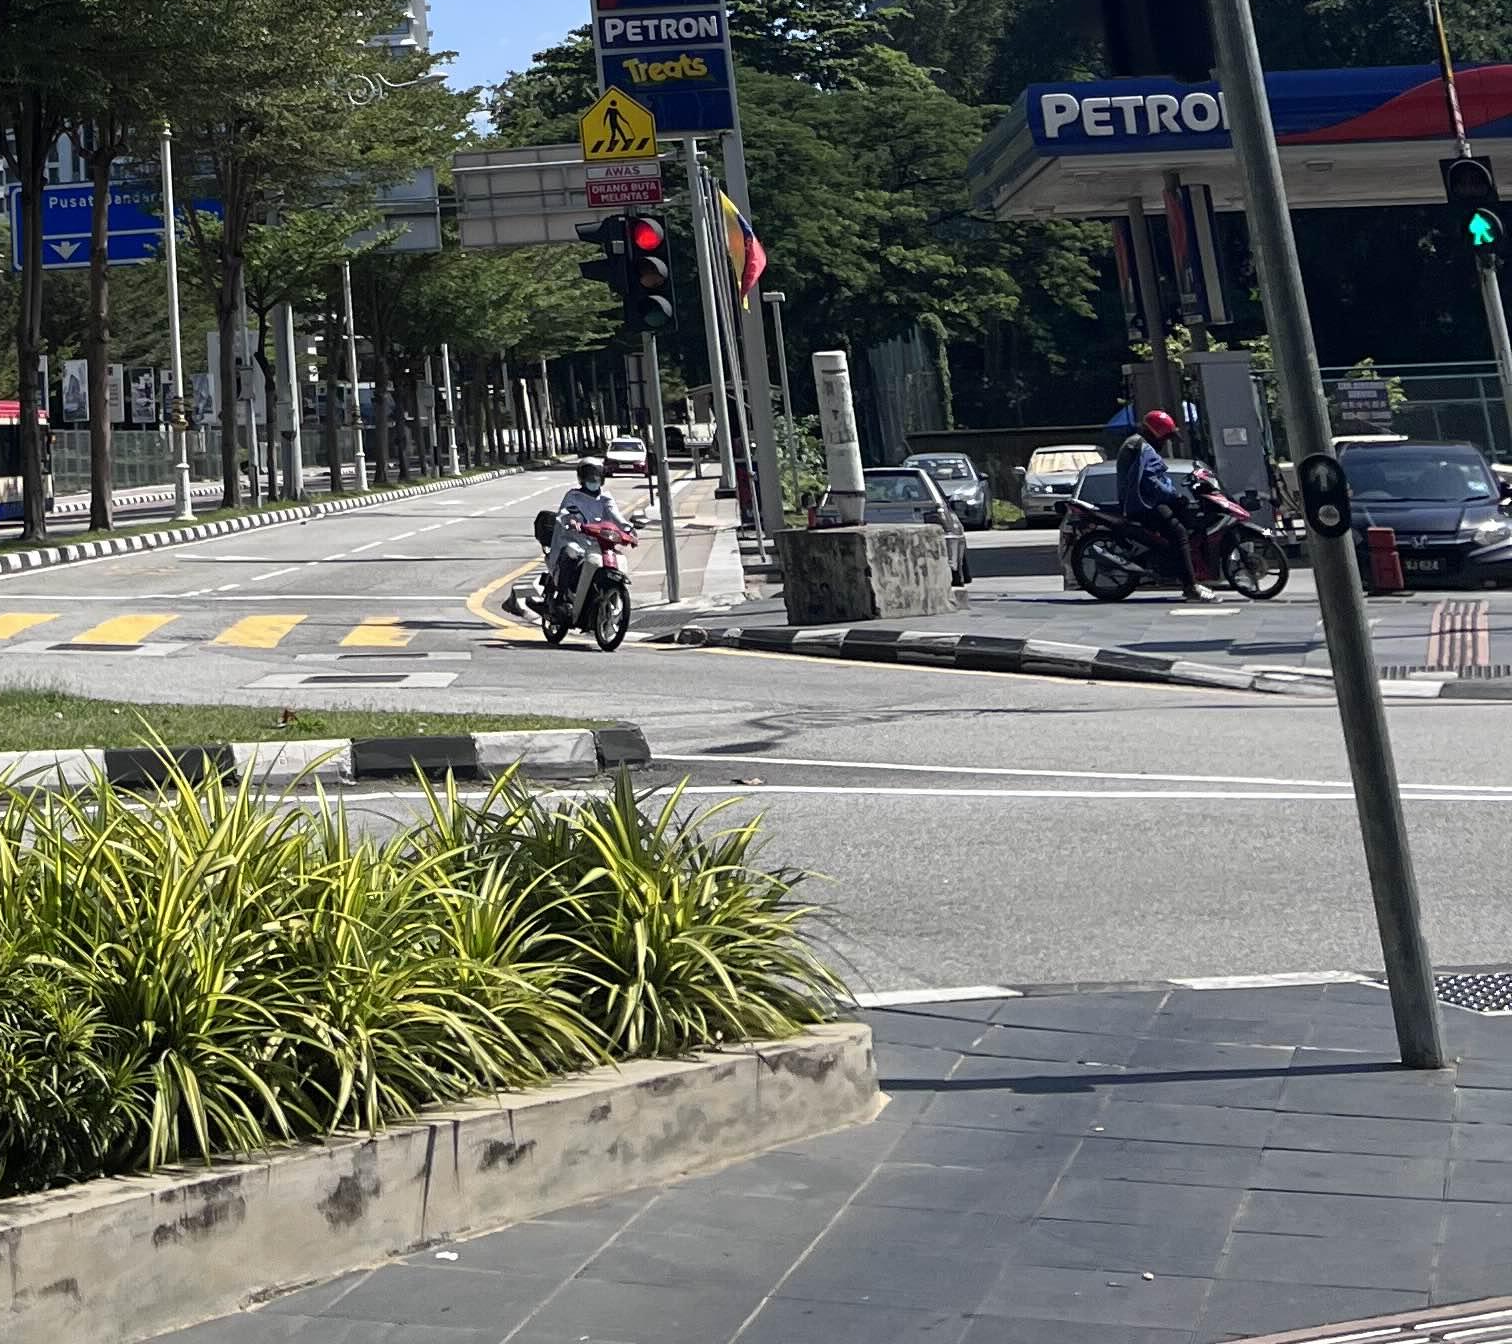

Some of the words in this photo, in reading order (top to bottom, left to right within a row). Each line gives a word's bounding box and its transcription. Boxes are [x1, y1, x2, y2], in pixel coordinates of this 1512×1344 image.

[605, 15, 718, 43] PETRON
[622, 53, 708, 84] Treats
[605, 165, 641, 177] AWAS
[591, 183, 628, 194] ORANG
[630, 181, 657, 191] BUTA
[49, 194, 94, 209] Pusat
[600, 192, 649, 202] MELINTAS
